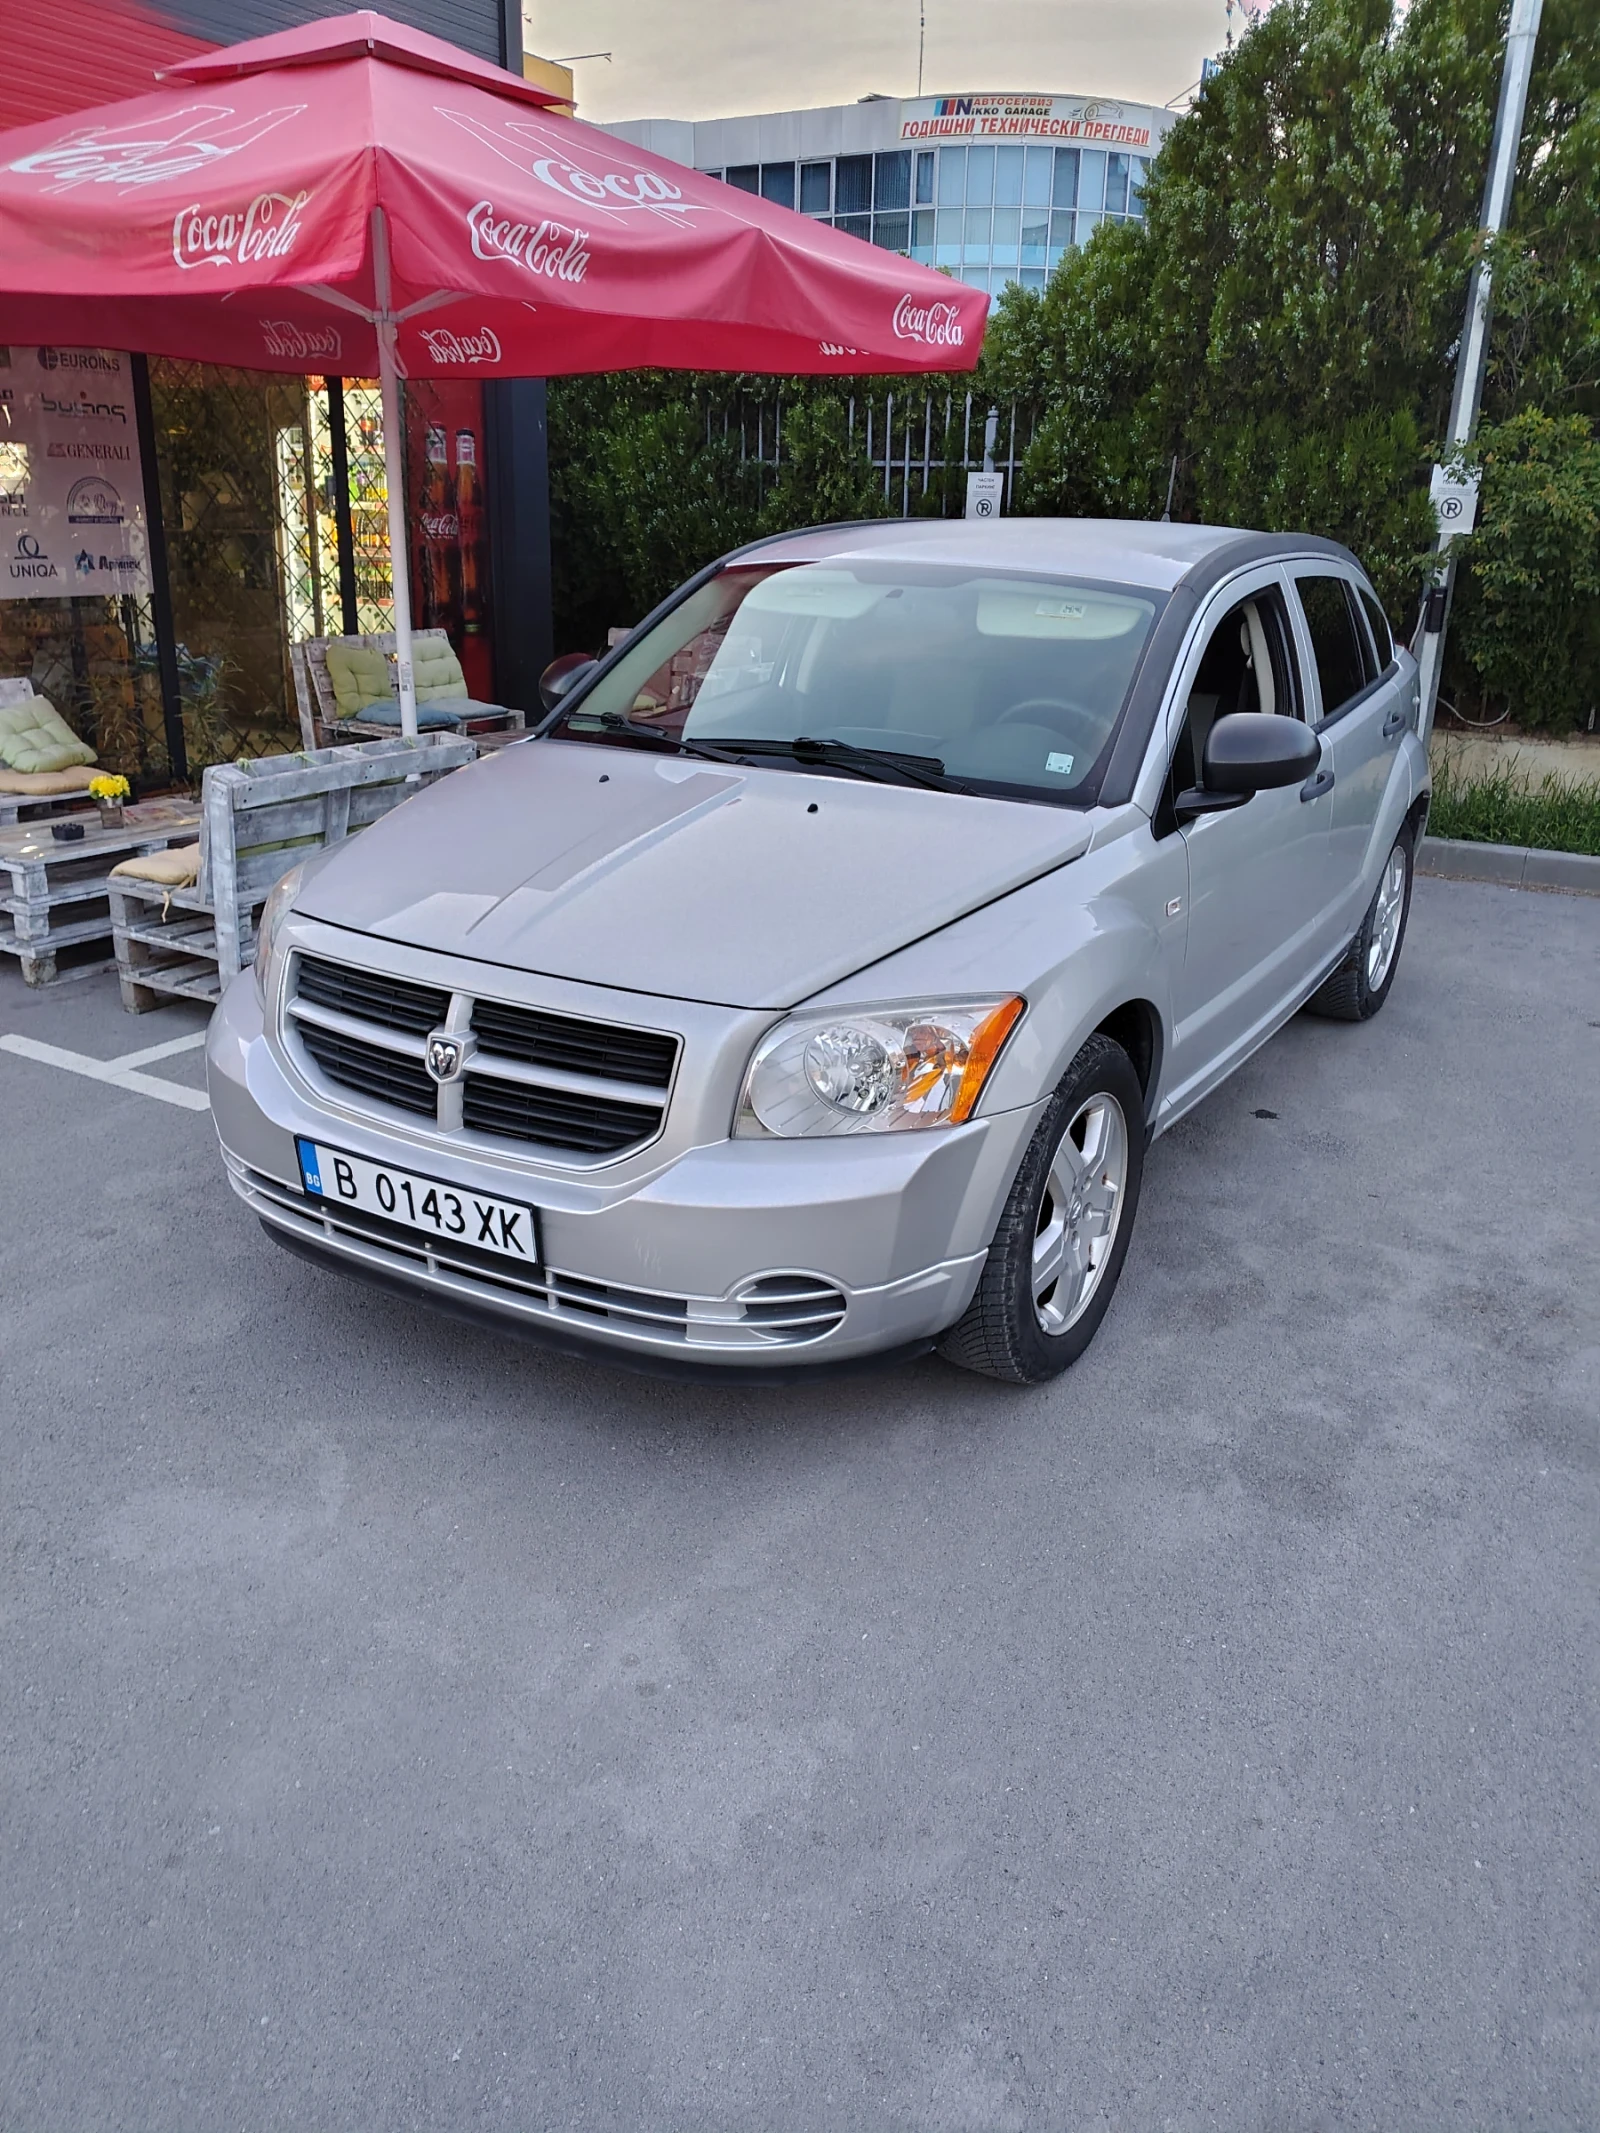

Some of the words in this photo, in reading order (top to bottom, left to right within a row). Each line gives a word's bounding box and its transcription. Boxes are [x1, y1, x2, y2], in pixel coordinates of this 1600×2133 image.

[973, 98, 1053, 107] АВТОСЕРВИЗ
[1004, 107, 1051, 116] GARAGE
[902, 118, 975, 139] ГОДИШНИ
[980, 118, 1080, 137] ТЕХНИЧЕСКИ
[1084, 122, 1149, 145] ПРЕГЛЕДИ
[172, 190, 309, 270] Coca-Cola
[467, 200, 591, 284] Coca-Cola
[892, 293, 965, 346] Coca-Cola
[60, 352, 120, 371] EUROINS
[67, 443, 130, 461] GENERALI
[9, 563, 58, 579] UNIQA
[305, 1173, 321, 1188] BG
[333, 1157, 358, 1199] B
[375, 1173, 466, 1234] 0143
[473, 1201, 526, 1254] XK
